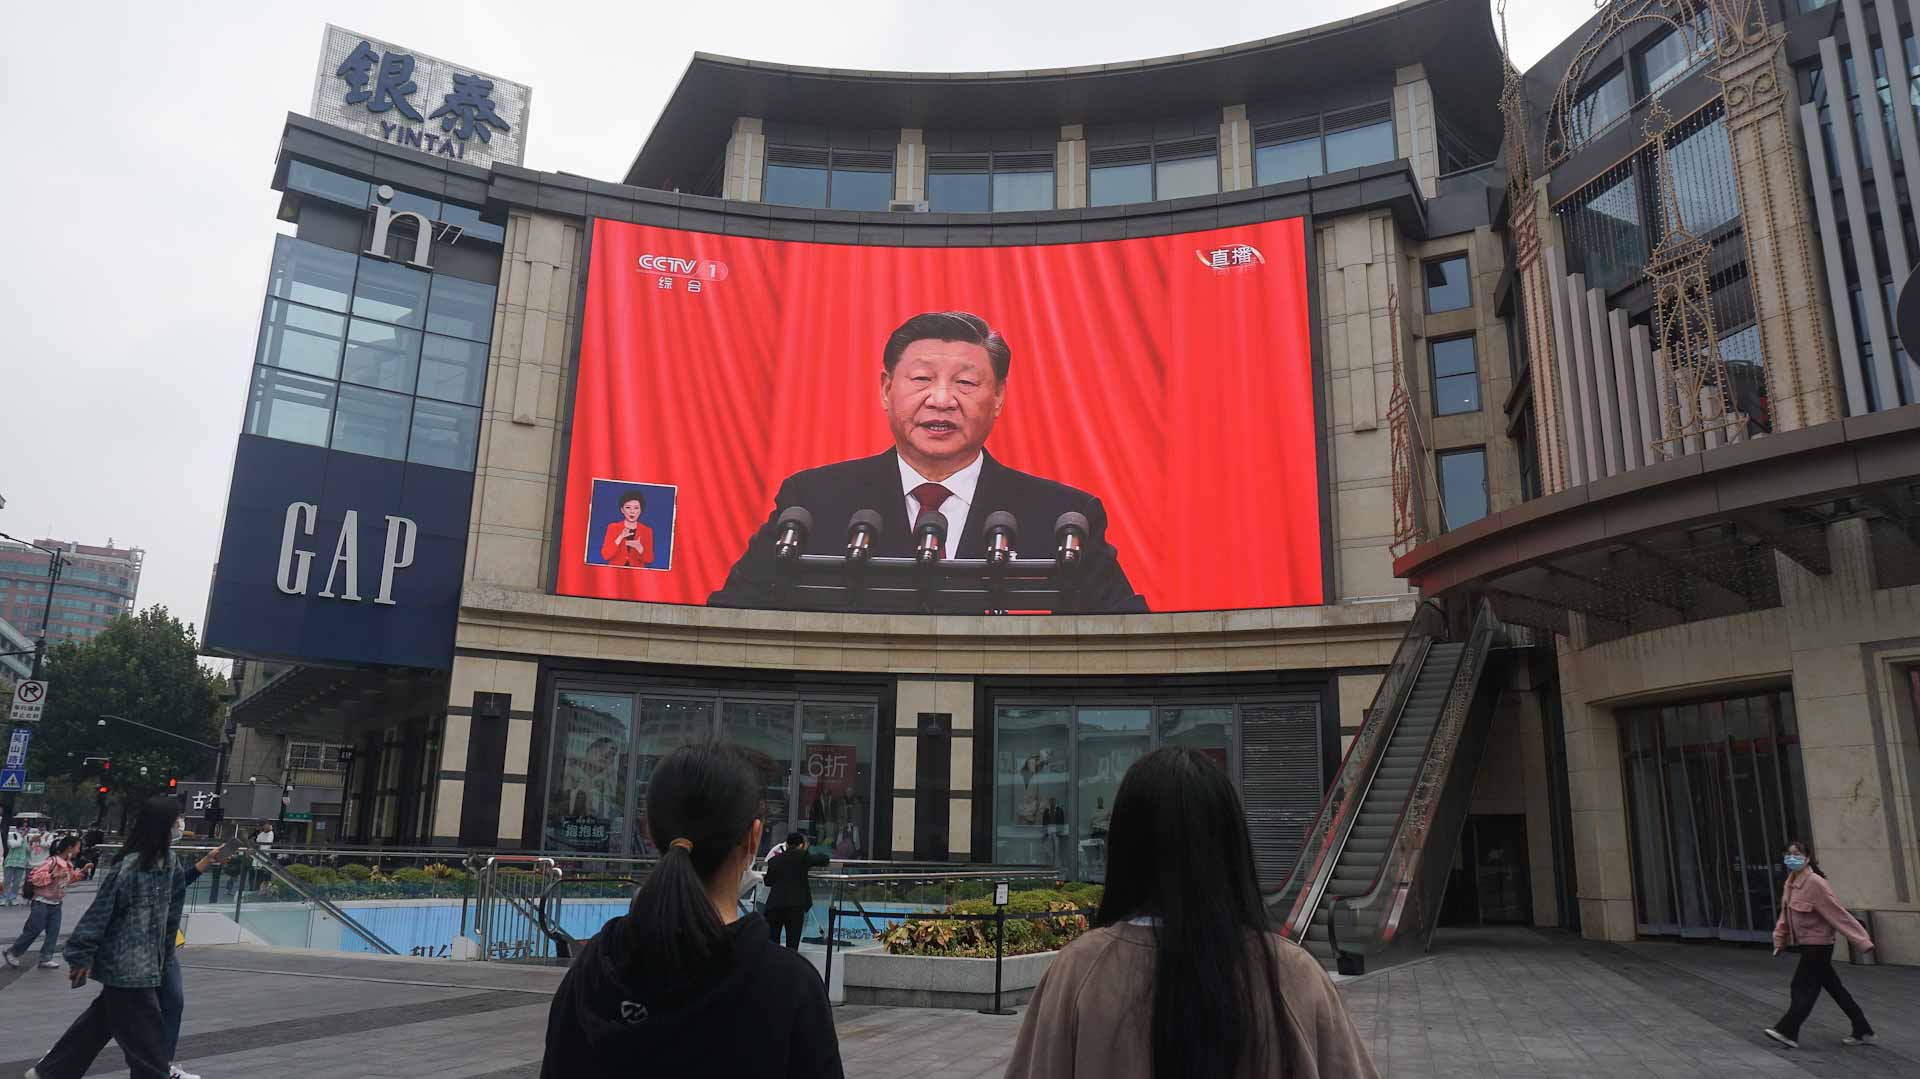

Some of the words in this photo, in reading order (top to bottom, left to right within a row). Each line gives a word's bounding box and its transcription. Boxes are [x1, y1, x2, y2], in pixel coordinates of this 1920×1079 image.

[336, 40, 511, 144] 银泰
[381, 120, 465, 159] YINTAI
[639, 254, 697, 274] CCTV
[1210, 247, 1253, 267] 直播
[658, 276, 701, 293] 综合
[277, 502, 418, 605] GAP
[807, 753, 849, 778] 6折
